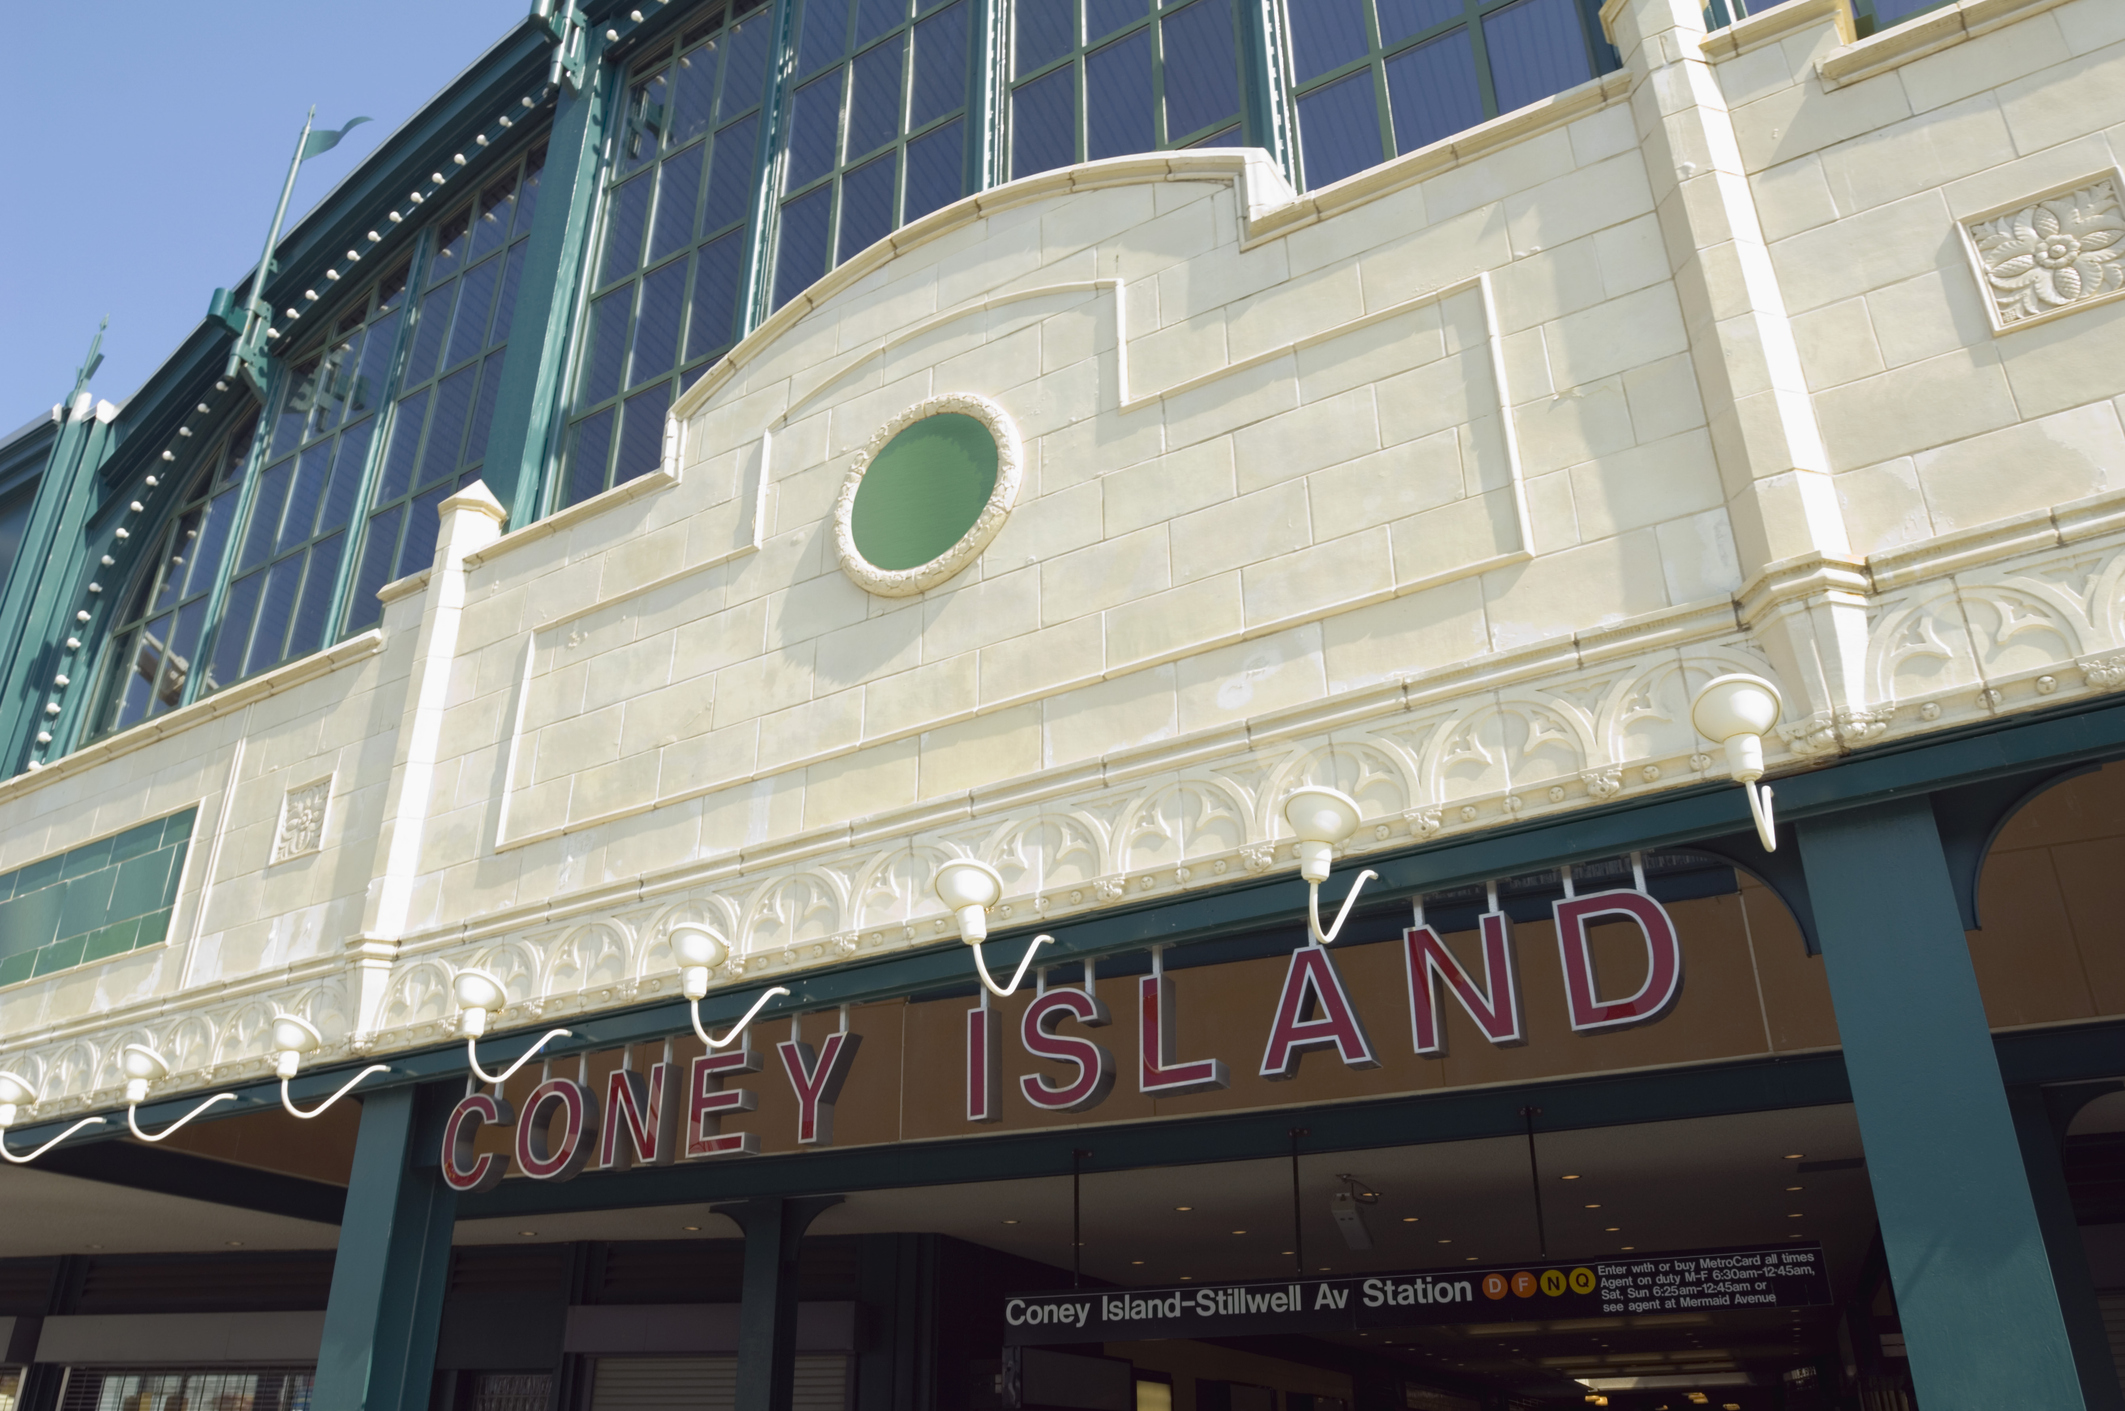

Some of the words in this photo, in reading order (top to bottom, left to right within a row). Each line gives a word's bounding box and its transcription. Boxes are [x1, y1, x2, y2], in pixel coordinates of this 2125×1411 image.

[441, 1031, 860, 1192] CONEY
[966, 889, 1683, 1123] ISLAND
[1597, 1265, 1627, 1276] Enter
[1631, 1262, 1655, 1274] with
[1658, 1263, 1671, 1272] or
[1674, 1260, 1696, 1272] buy
[1699, 1255, 1761, 1269] MetroCard
[1765, 1253, 1778, 1264] all
[1781, 1252, 1815, 1263] times
[1488, 1278, 1502, 1293] D
[1518, 1277, 1529, 1292] F
[1547, 1276, 1561, 1291] N
[1575, 1273, 1590, 1288] Q
[1600, 1276, 1634, 1289] Agent
[1637, 1276, 1652, 1285] on
[1655, 1273, 1681, 1285] duty
[1684, 1270, 1708, 1282] M-F
[1601, 1289, 1624, 1300] Sat,
[1627, 1287, 1649, 1299] Sun
[1754, 1281, 1767, 1290] or
[1005, 1299, 1091, 1327] Coney
[1314, 1283, 1349, 1310] Av
[1363, 1276, 1473, 1307] Station
[1603, 1303, 1624, 1312] see
[1628, 1299, 1661, 1313] agent
[1664, 1298, 1677, 1309] at
[1680, 1294, 1731, 1308] Mermaid
[1734, 1293, 1776, 1304] Avenue
